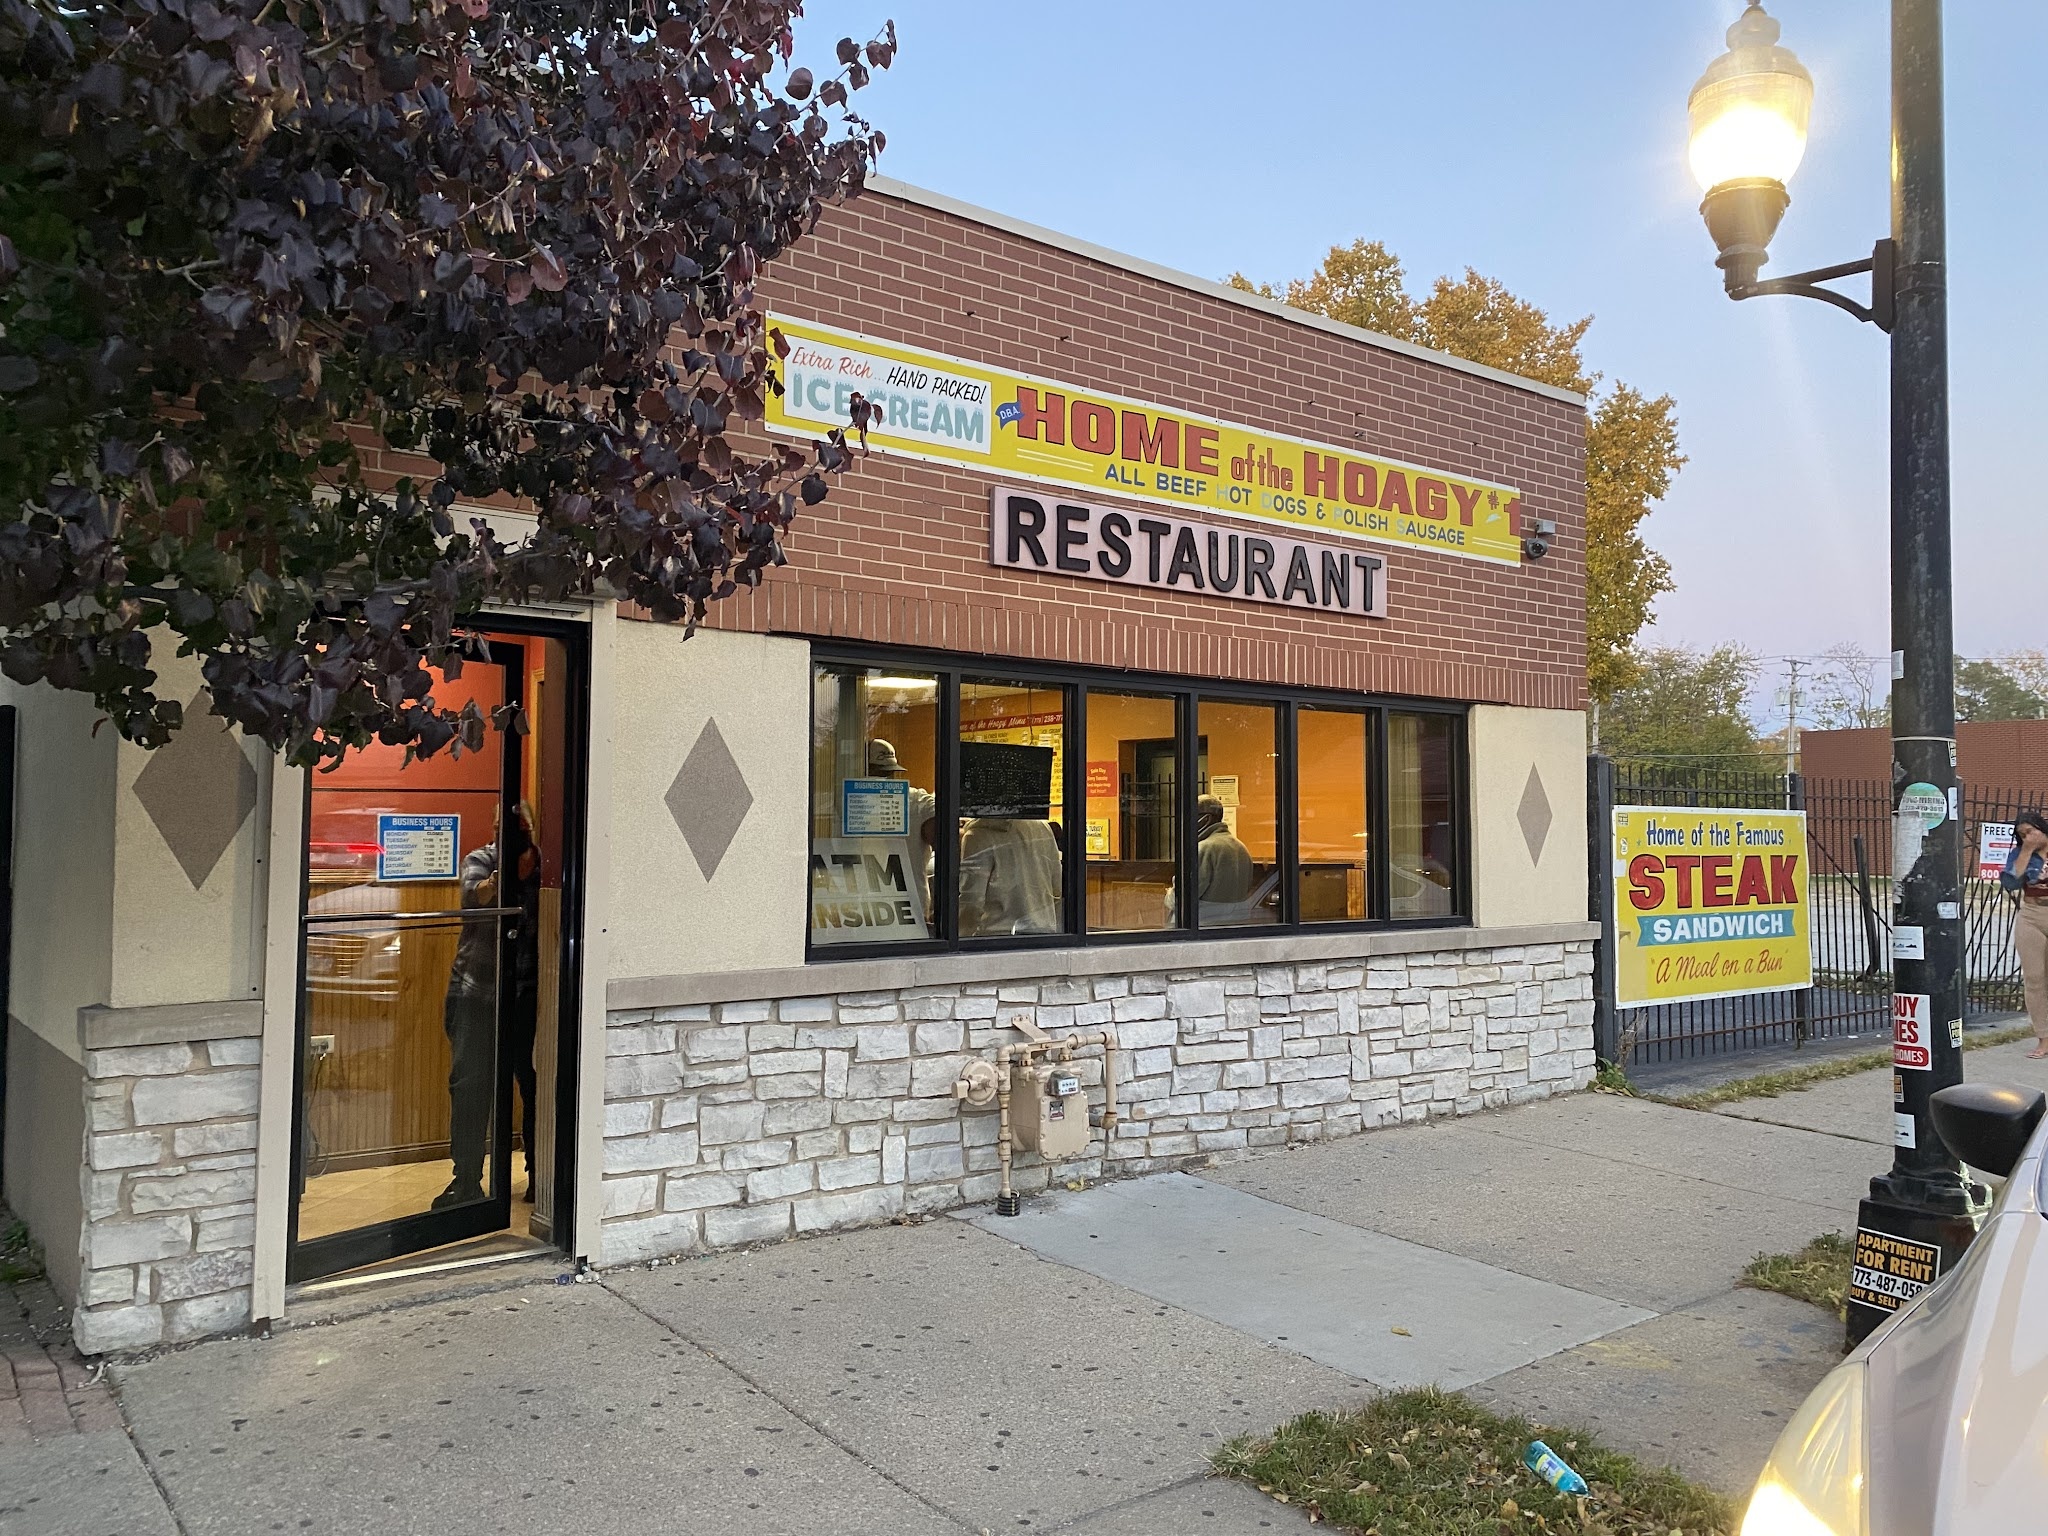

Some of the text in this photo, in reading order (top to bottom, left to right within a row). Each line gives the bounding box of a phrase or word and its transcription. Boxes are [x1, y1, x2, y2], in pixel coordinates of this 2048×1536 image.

[792, 346, 834, 371] Extra
[886, 366, 988, 405] HAND PACKED!
[792, 371, 984, 444] ICE CREAM
[1016, 385, 1219, 477] HOME
[1231, 443, 1257, 484] of
[1257, 454, 1293, 491] the
[1303, 451, 1483, 526] HOAGY
[1105, 463, 1466, 546] ALL BEEF HOT DOGS & POLISH SAUSAGE
[1006, 495, 1382, 612] RESTAURANT
[854, 782, 883, 790] BUSINESS
[392, 817, 453, 826] BUSINESS HOURS
[1646, 818, 1685, 847] Home
[1691, 821, 1704, 847] of
[1709, 821, 1730, 847] the
[1735, 821, 1784, 847] Famous
[1984, 826, 2006, 836] FREE
[1628, 853, 1799, 911] STEAK
[1981, 869, 2000, 879] 800
[1653, 913, 1784, 943] SANDWICH
[1675, 952, 1720, 983] Meal
[1722, 959, 1740, 976] on
[1744, 959, 1753, 973] a
[1893, 995, 1919, 1019] BUY
[1858, 1233, 1934, 1263] APARTMENT
[1855, 1247, 1933, 1282] FOR RENT
[1868, 1291, 1875, 1302] &
[1877, 1295, 1897, 1308] SELL
